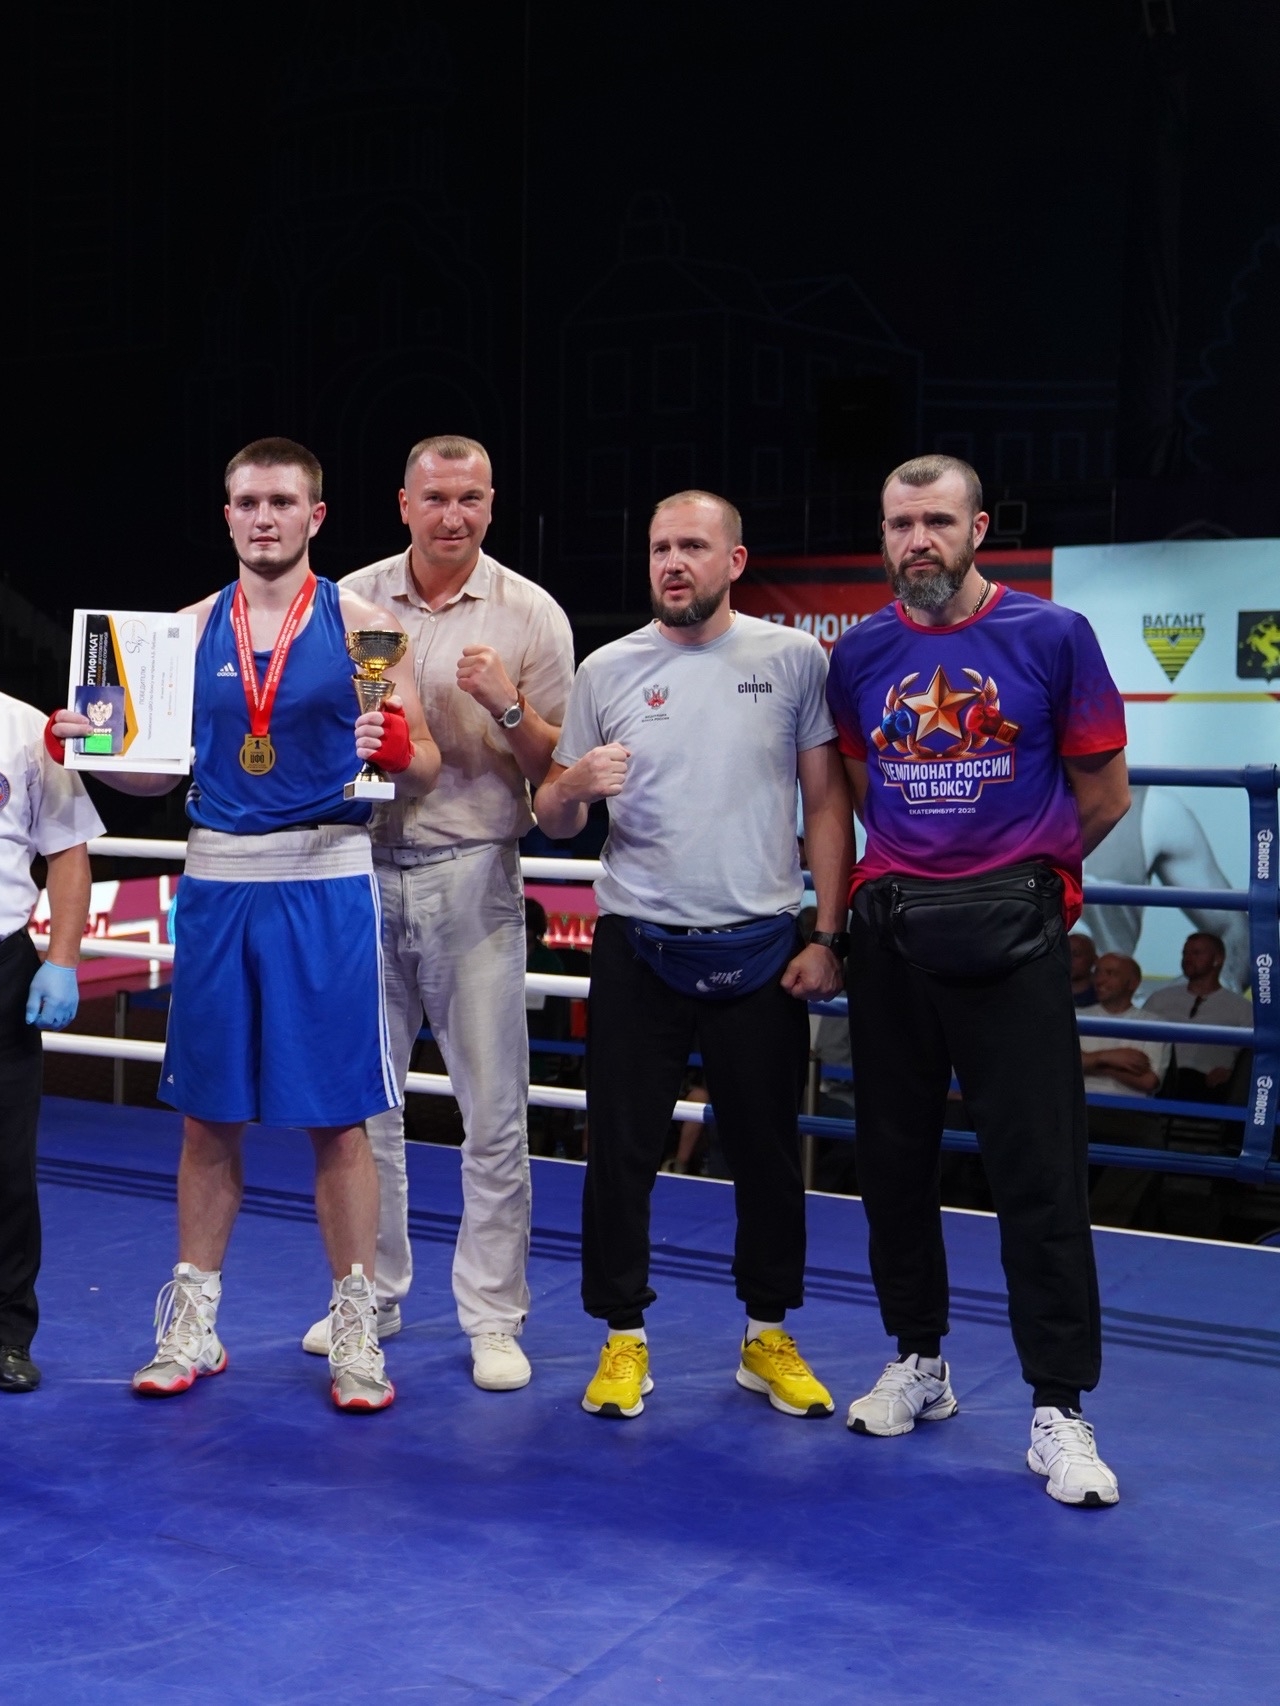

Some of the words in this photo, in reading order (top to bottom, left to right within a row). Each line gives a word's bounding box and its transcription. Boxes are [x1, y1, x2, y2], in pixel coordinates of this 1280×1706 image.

[1142, 613, 1205, 628] ВАГАНТ
[86, 632, 99, 687] РТИФИКАТ
[737, 681, 773, 694] clinch
[882, 761, 952, 781] ЧЕМПИОНАТ
[956, 755, 1010, 778] РОССИИ
[910, 782, 927, 798] ПО
[931, 780, 973, 797] БОКСУ
[1258, 842, 1270, 879] CROCUS
[1258, 967, 1271, 1004] CROCUS
[1254, 1088, 1269, 1126] CROCUS
